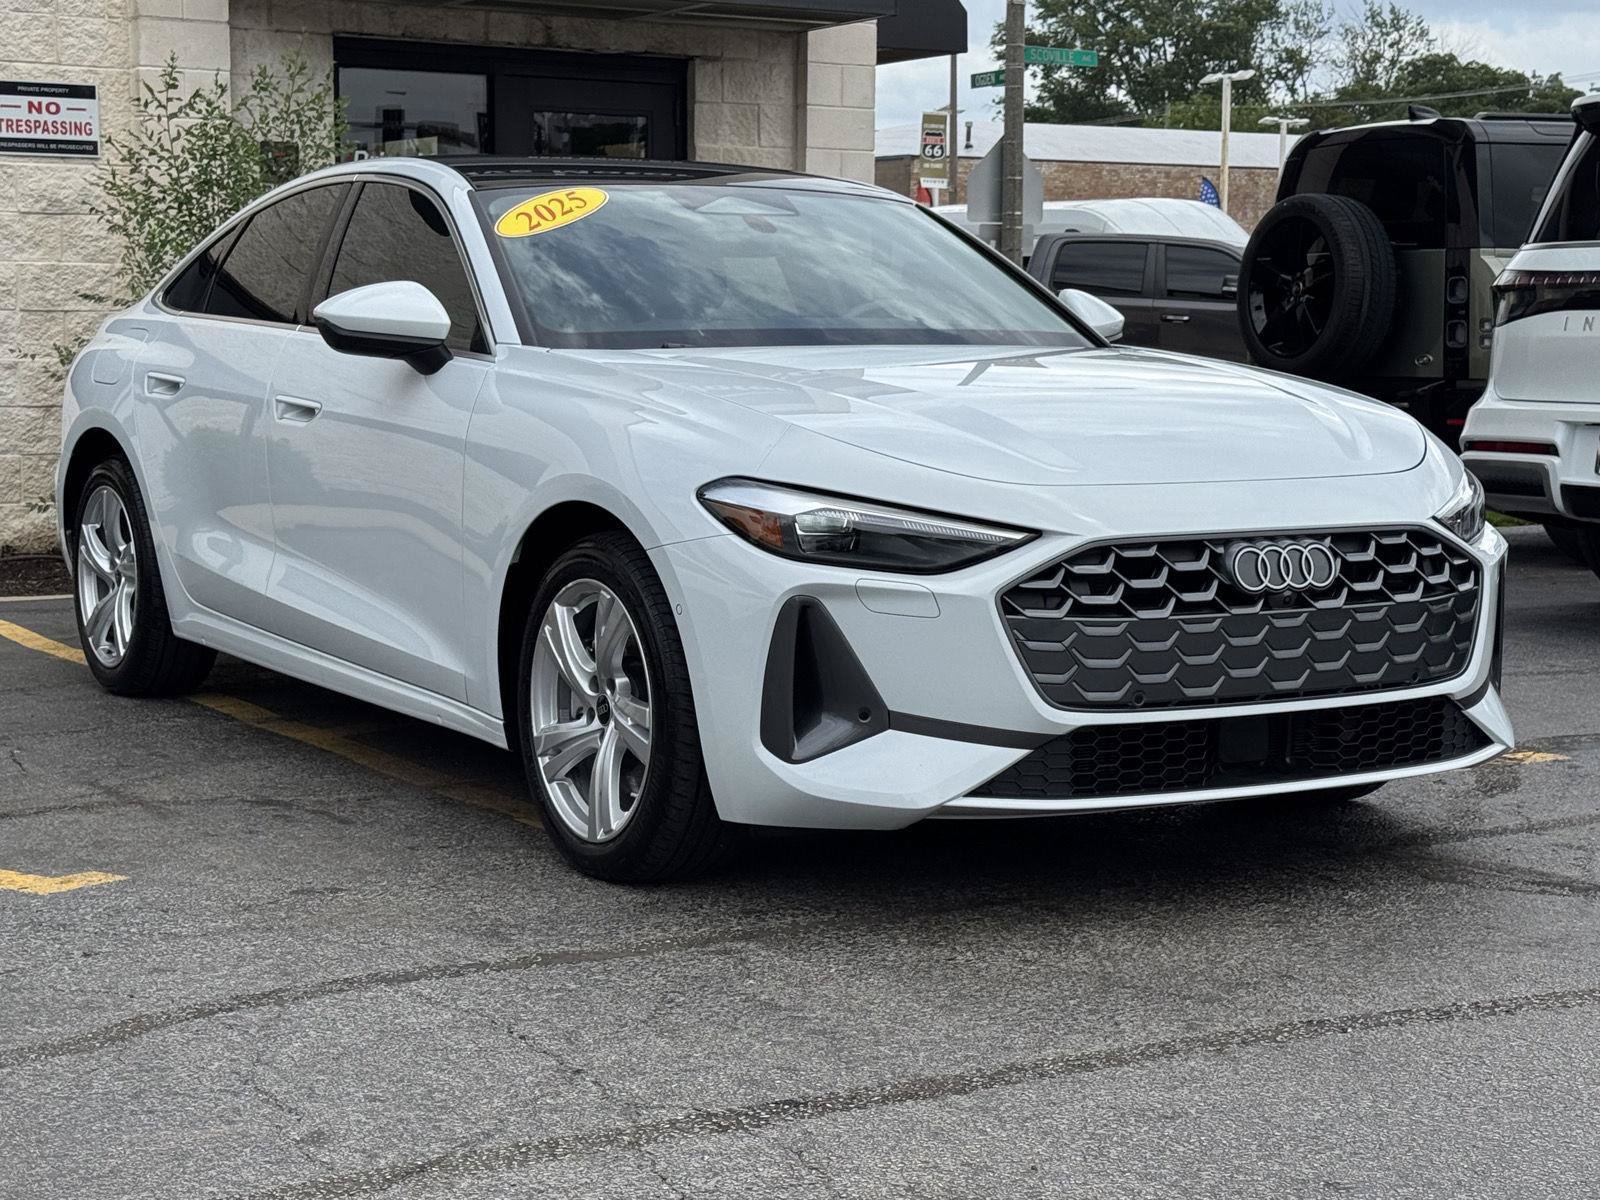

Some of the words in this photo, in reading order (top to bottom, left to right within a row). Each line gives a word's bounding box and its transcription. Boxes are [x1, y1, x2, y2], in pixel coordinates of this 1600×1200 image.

[1030, 49, 1074, 61] SCOVILLE
[27, 100, 61, 115] NO
[925, 144, 942, 157] 66
[516, 191, 587, 231] 2025
